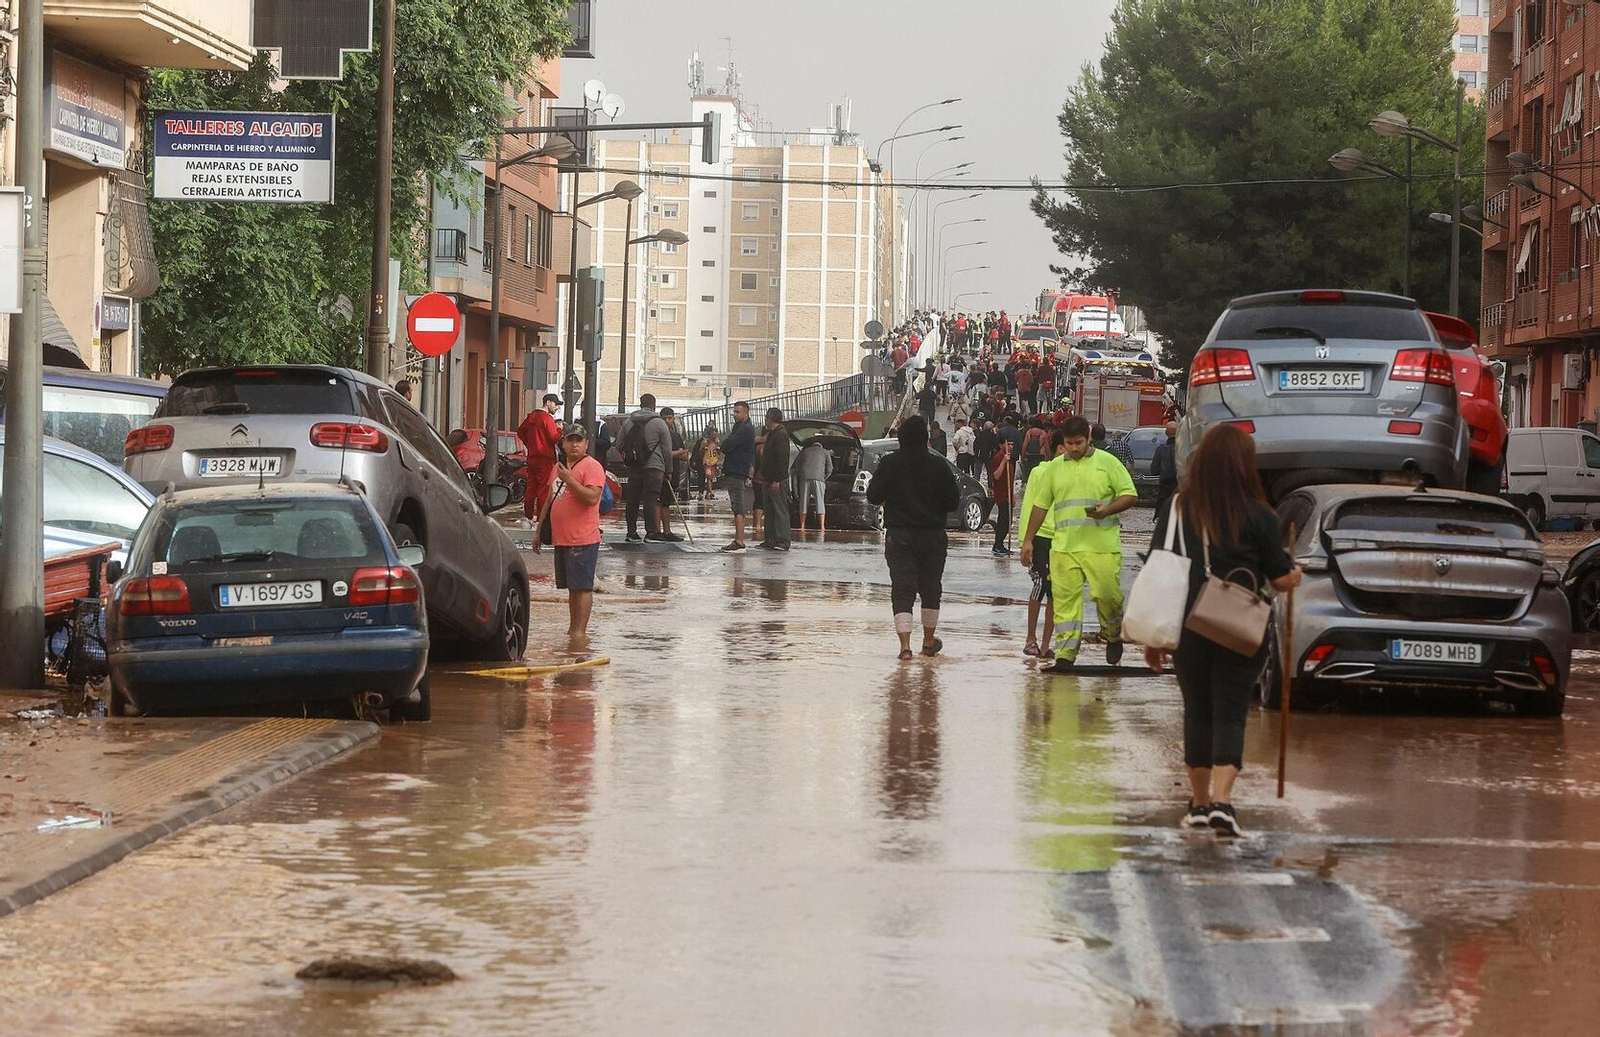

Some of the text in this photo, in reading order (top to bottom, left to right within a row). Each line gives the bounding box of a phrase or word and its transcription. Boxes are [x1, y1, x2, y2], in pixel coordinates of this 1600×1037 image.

[165, 119, 323, 137] TALLERES ALCAIDE
[171, 143, 316, 153] CARPINTERIA DE HIERRO Y ALUMINIO
[185, 161, 299, 172] MAMPARAS DE BAÑO
[192, 174, 293, 185] REJAS EXTENSIBLES
[181, 187, 302, 198] CERRAJERIA ARTISTICA
[1291, 373, 1360, 385] 8852 GXF
[210, 458, 277, 472] 3928 MJW
[234, 584, 314, 602] V 1697 GS
[158, 611, 368, 627] VOLVO V40
[1403, 643, 1477, 660] 7089 MHB
